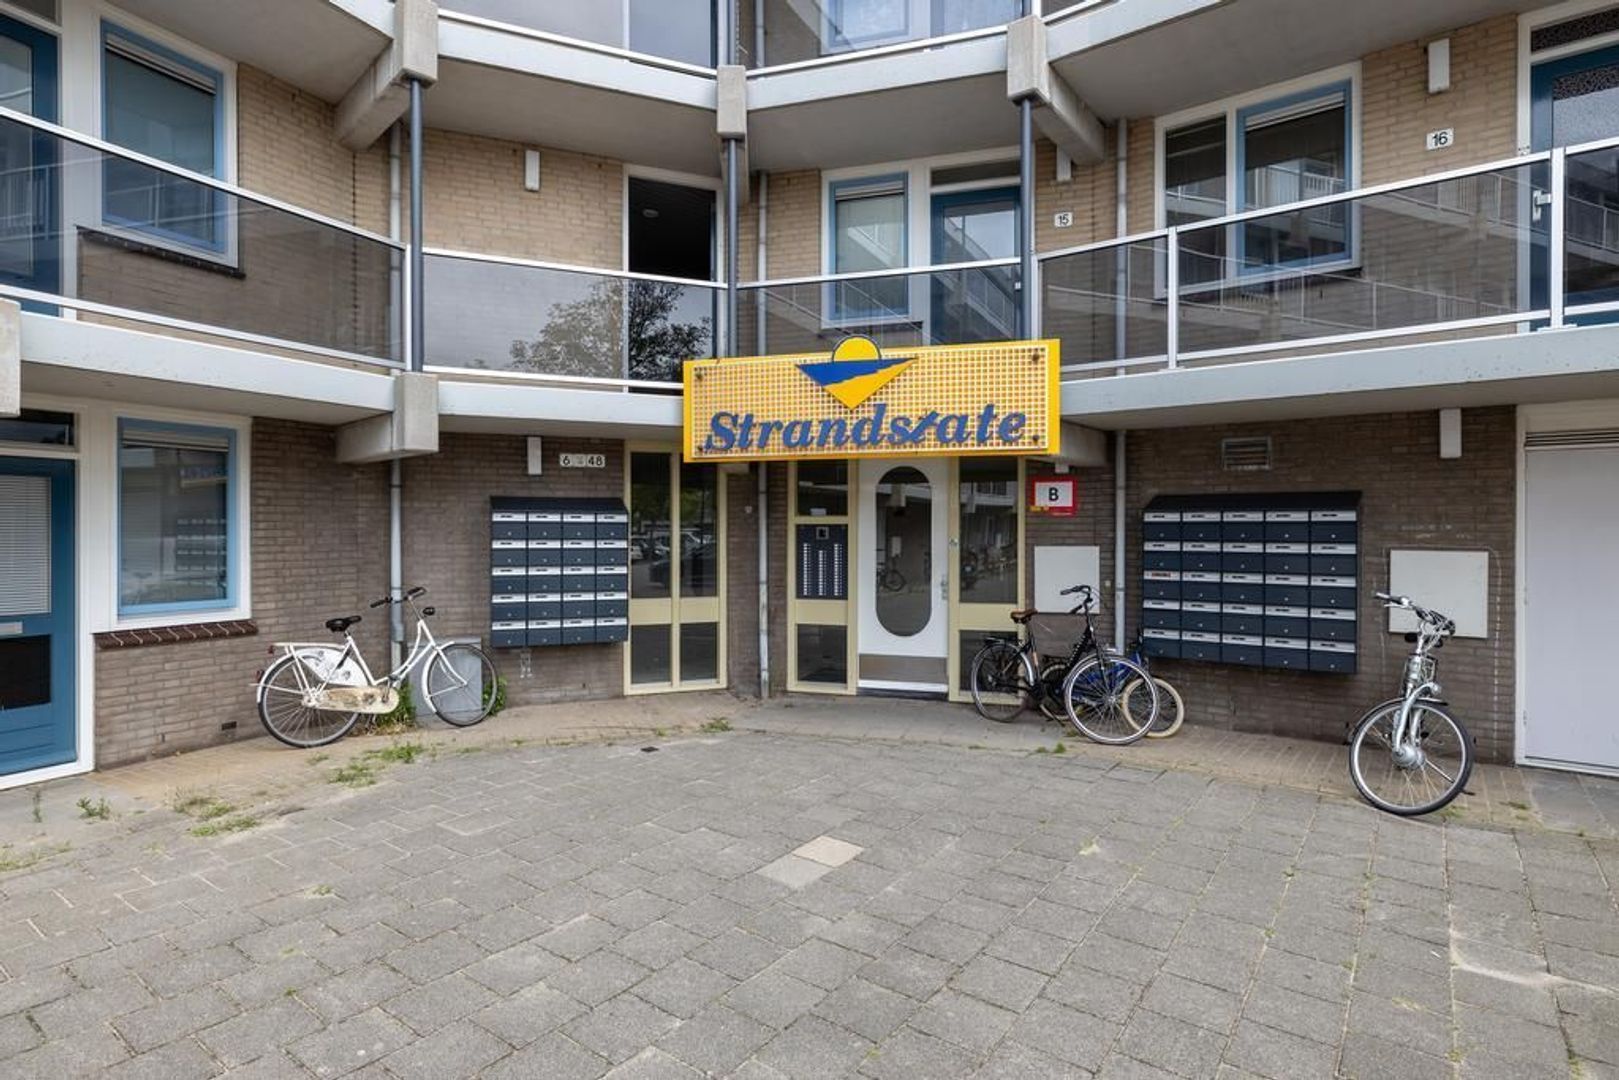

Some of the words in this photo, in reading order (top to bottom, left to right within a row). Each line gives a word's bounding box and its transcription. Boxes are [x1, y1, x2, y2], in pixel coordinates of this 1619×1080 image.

[1432, 131, 1448, 147] 16
[1058, 213, 1070, 226] 15
[563, 455, 571, 466] 6
[588, 455, 603, 466] 48
[1048, 487, 1059, 501] B
